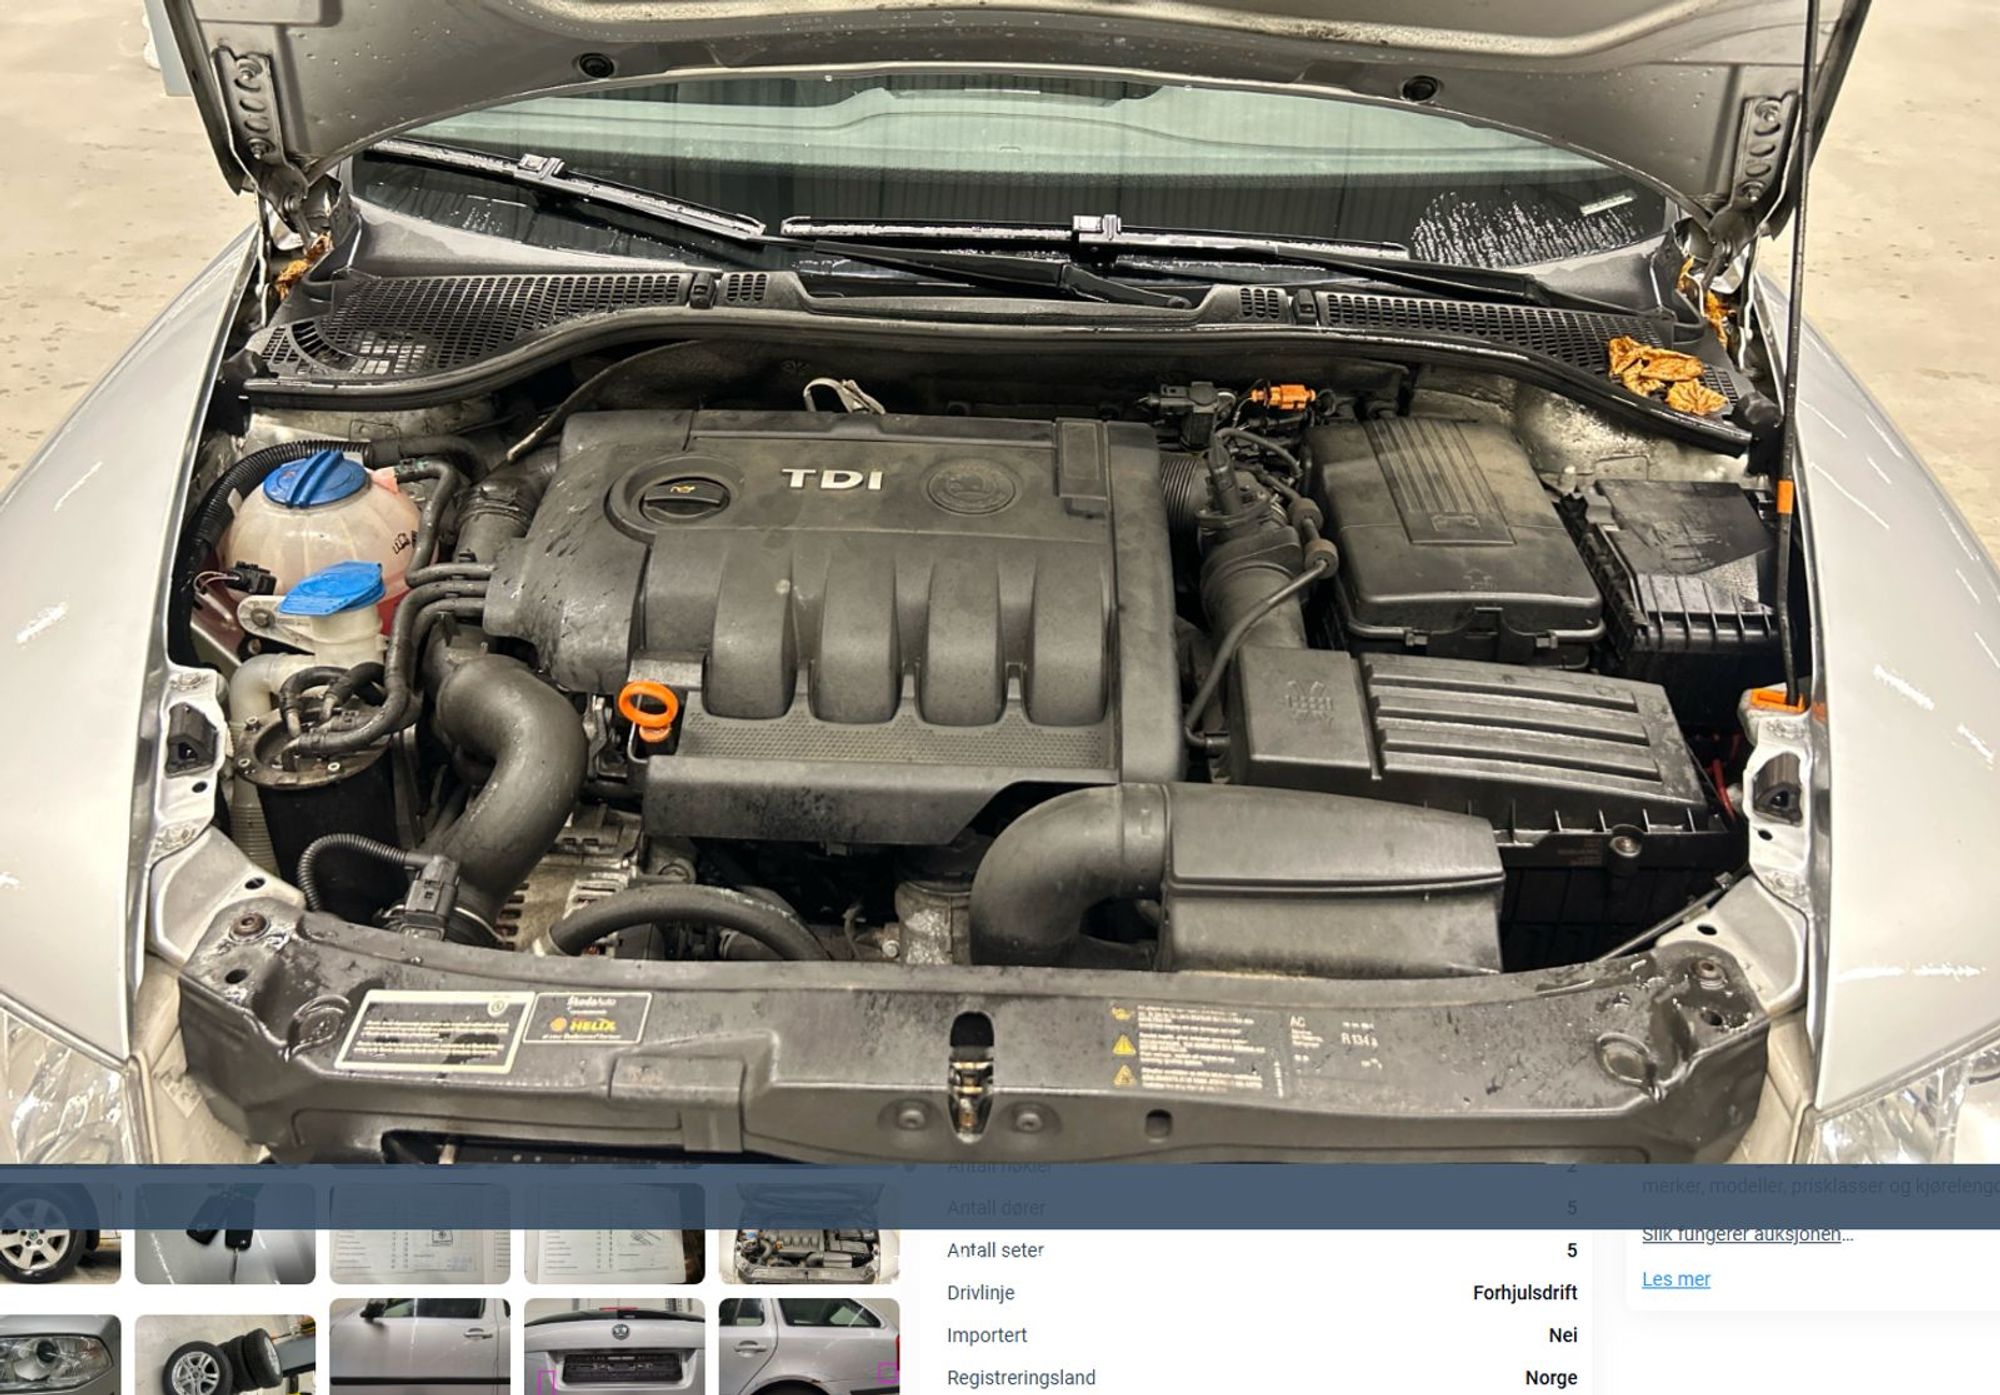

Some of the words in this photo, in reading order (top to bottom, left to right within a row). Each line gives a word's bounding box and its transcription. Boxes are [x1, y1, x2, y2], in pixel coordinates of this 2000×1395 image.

[782, 468, 883, 490] TDI
[1791, 1177, 1883, 1197] prisklasser
[1889, 1182, 1910, 1197] og
[947, 1200, 995, 1216] Antall
[1001, 1200, 1046, 1216] dører
[1568, 1200, 1577, 1215] 5
[947, 1242, 995, 1258] Antall
[1002, 1243, 1045, 1258] seter
[1568, 1243, 1578, 1258] 5
[1642, 1272, 1673, 1287] Les
[1678, 1274, 1712, 1287] mer
[948, 1284, 1015, 1304] Drivlinje
[1474, 1284, 1578, 1304] Forhjulsdrift
[948, 1327, 1027, 1346] Importert
[1549, 1326, 1578, 1342] Nei
[948, 1369, 1096, 1389] Registreringsland
[1526, 1369, 1578, 1389] Norge
